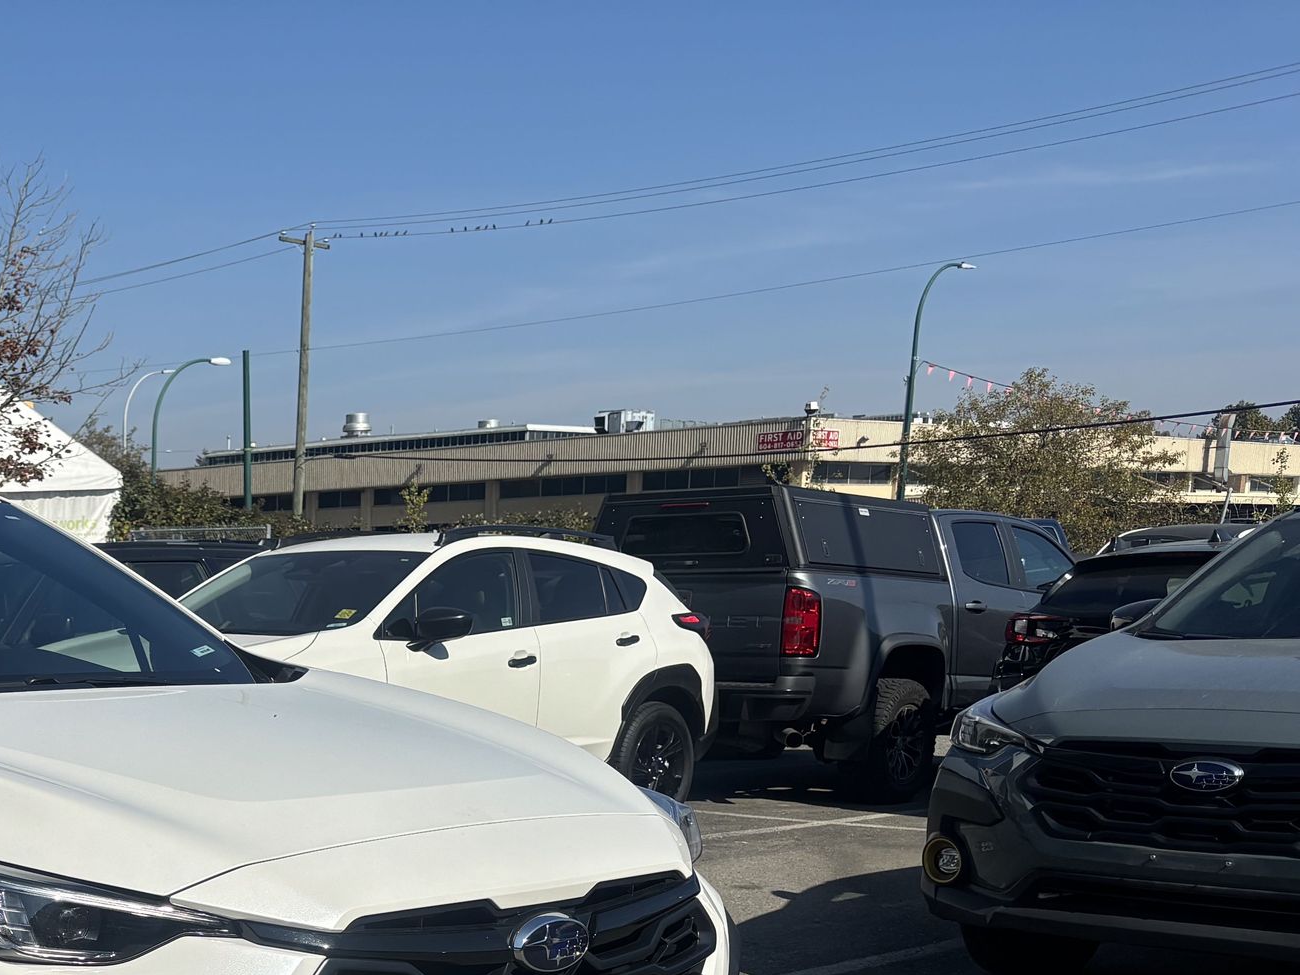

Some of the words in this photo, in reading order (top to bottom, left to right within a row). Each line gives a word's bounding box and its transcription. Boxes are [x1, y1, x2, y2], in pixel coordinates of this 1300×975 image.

[760, 433, 783, 442] FIRST
[787, 431, 803, 440] AID
[829, 431, 839, 440] AID
